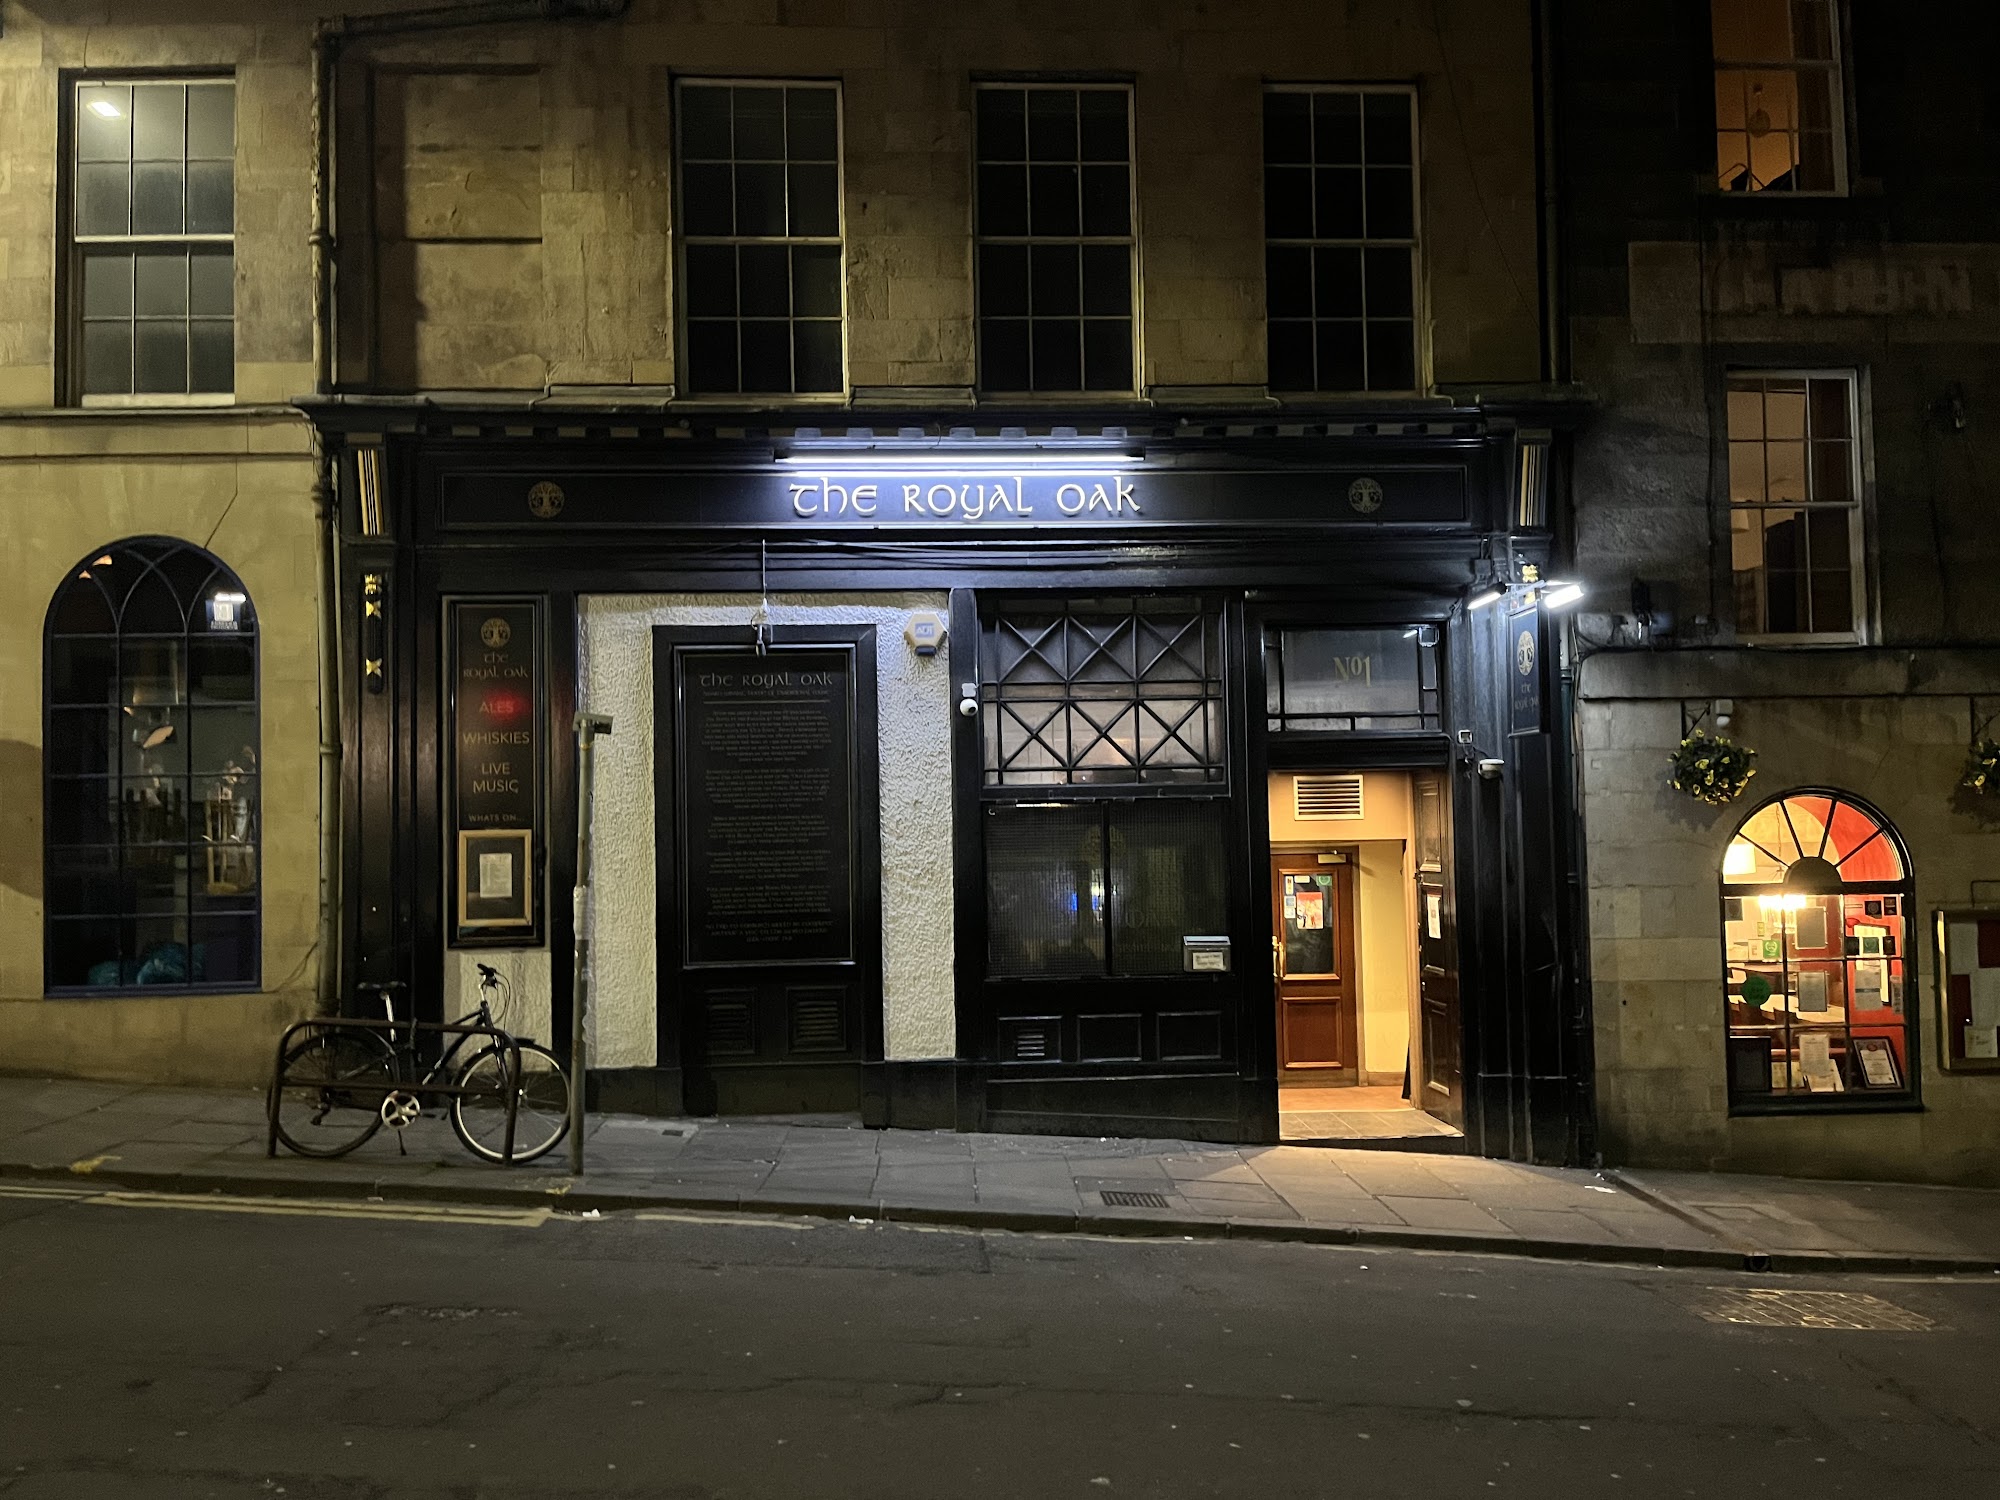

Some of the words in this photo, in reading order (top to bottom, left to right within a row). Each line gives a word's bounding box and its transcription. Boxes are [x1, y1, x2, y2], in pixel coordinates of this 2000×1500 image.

[479, 700, 514, 714] ALES
[463, 731, 530, 745] WHISKIES
[481, 762, 510, 775] LIVE
[473, 779, 519, 794] MUSIC
